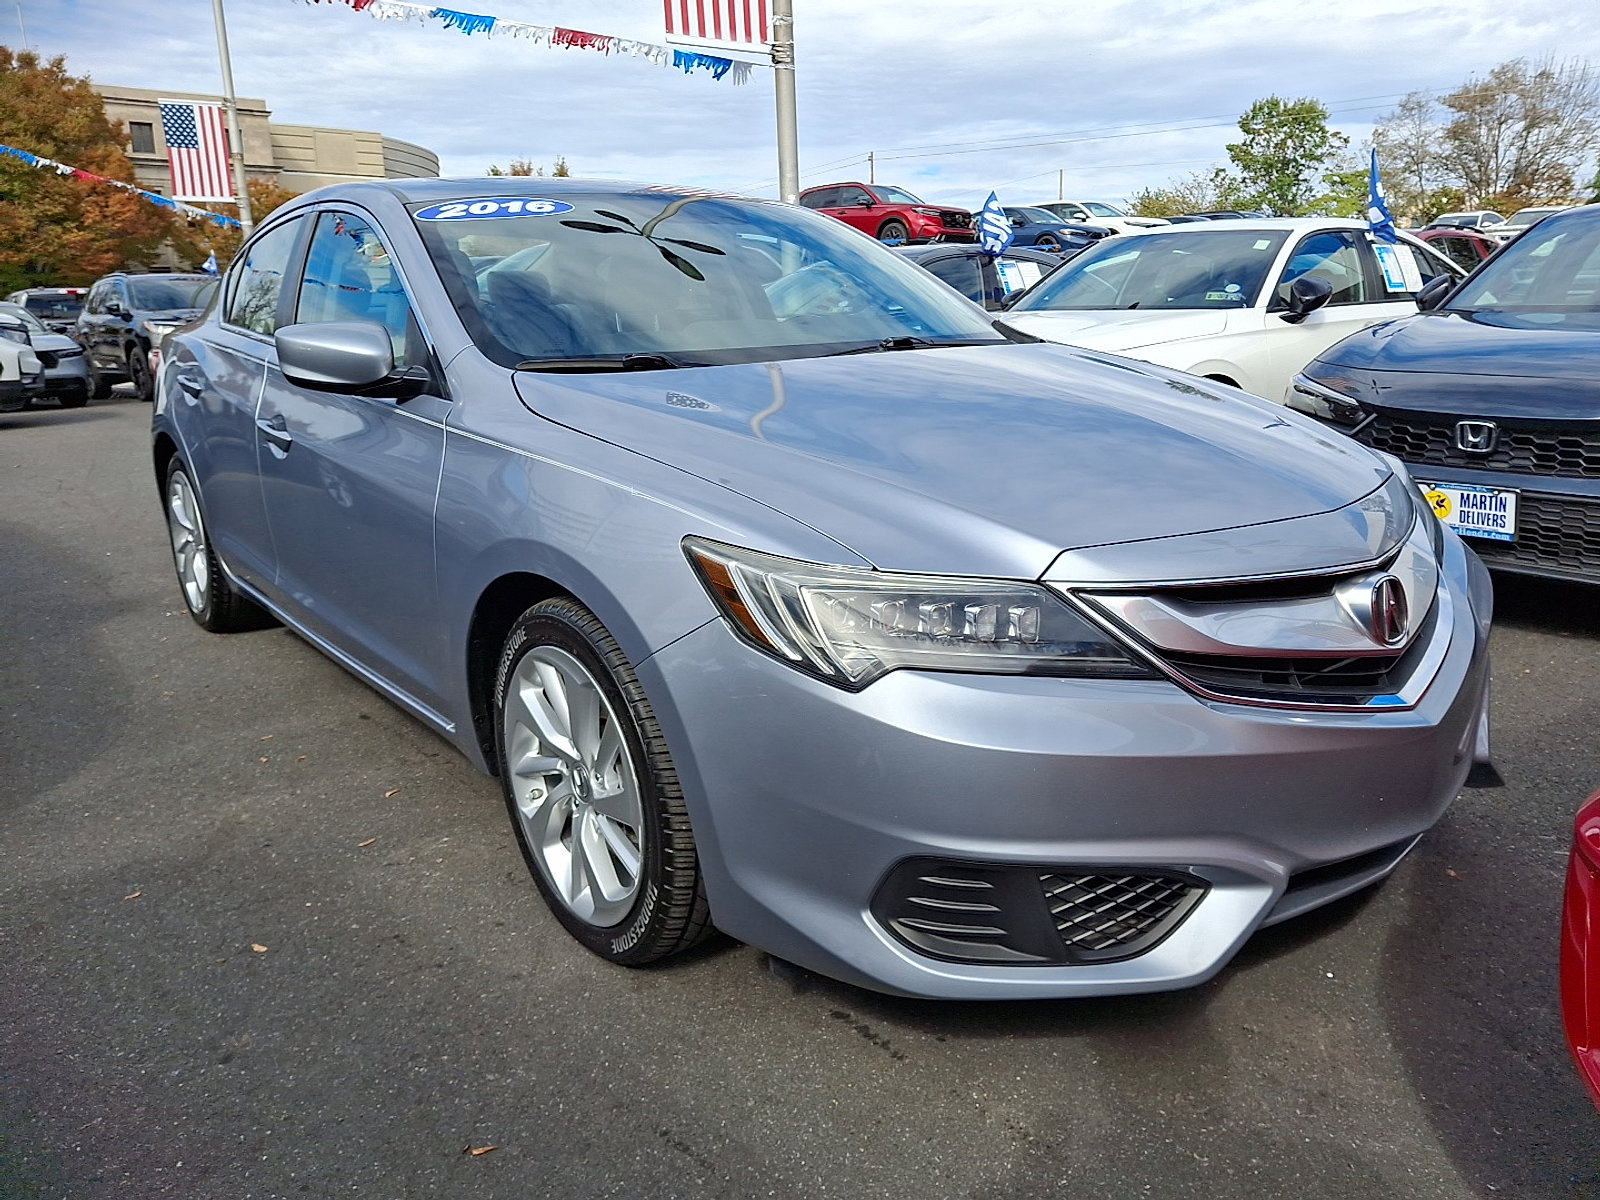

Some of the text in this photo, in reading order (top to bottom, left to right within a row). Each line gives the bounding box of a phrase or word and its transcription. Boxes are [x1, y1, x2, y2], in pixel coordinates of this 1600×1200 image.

[435, 201, 556, 218] 2016
[1459, 492, 1507, 512] MARTIN
[1459, 509, 1507, 528] DELIVERS
[494, 625, 528, 709] BRIDGESTONE
[611, 879, 659, 954] BRIDGESTONE
